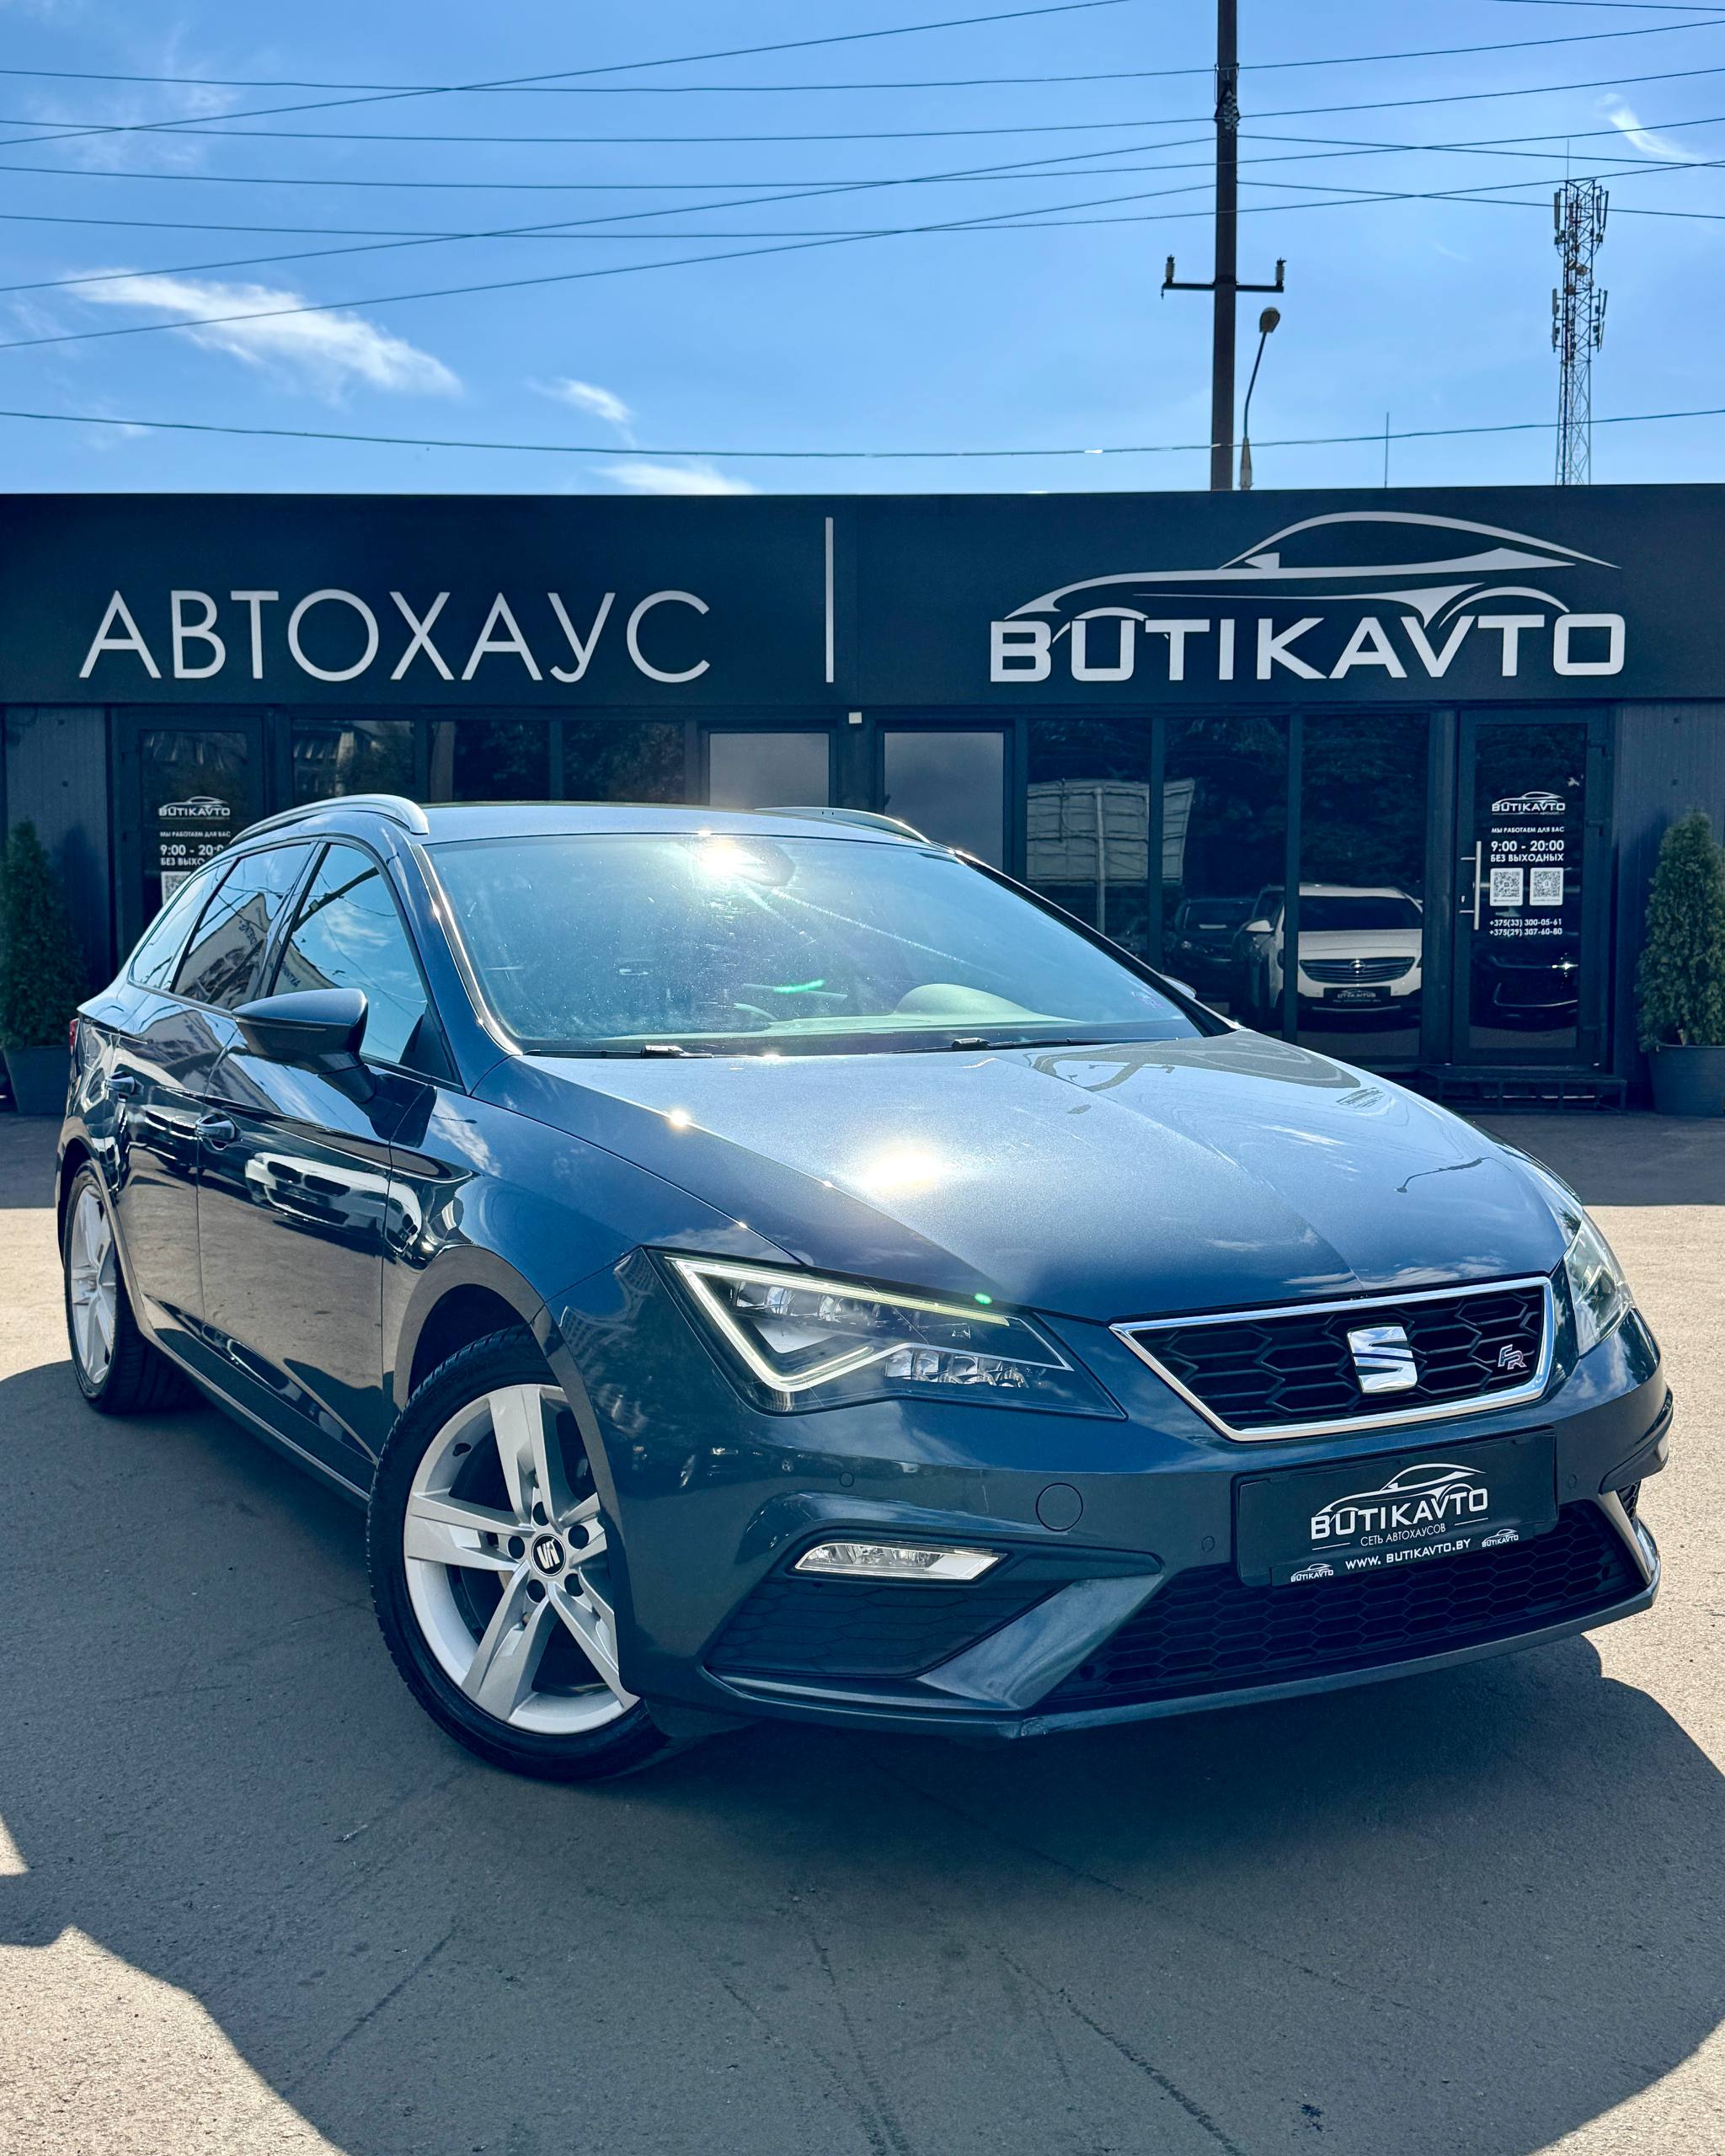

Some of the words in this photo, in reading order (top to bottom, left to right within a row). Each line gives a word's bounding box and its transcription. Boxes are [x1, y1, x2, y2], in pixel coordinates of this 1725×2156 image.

[78, 588, 711, 684] АВТОХАУС
[990, 612, 1626, 684] BUTIKAVTO
[158, 808, 231, 816] BUTIKAVTO
[1492, 803, 1566, 812] BUTIKAVTO
[160, 844, 186, 856] 9:00
[1491, 841, 1518, 852] 9:00
[1530, 840, 1564, 851] 20:00
[161, 857, 176, 866] БЕЗ
[178, 857, 206, 866] ВЫХО
[1490, 854, 1506, 862] БЕЗ
[1508, 853, 1564, 862] ВЫХОДНЫХ
[1489, 919, 1523, 927] +375(33)
[1524, 918, 1562, 926] 300-05-61
[1489, 928, 1523, 937] +375(29)
[1524, 927, 1562, 936] 307-60-80
[1311, 1487, 1488, 1540] BUTIKAVTO
[1360, 1534, 1384, 1547] СЕТЬ
[1386, 1523, 1446, 1543] АВТОХАУСОВ
[1482, 1534, 1519, 1548] BUTIKAVTO
[1345, 1556, 1381, 1570] WWW.
[1386, 1539, 1471, 1564] BUTIKAVTO.BY
[1290, 1569, 1334, 1582] BUTIKAVTO
